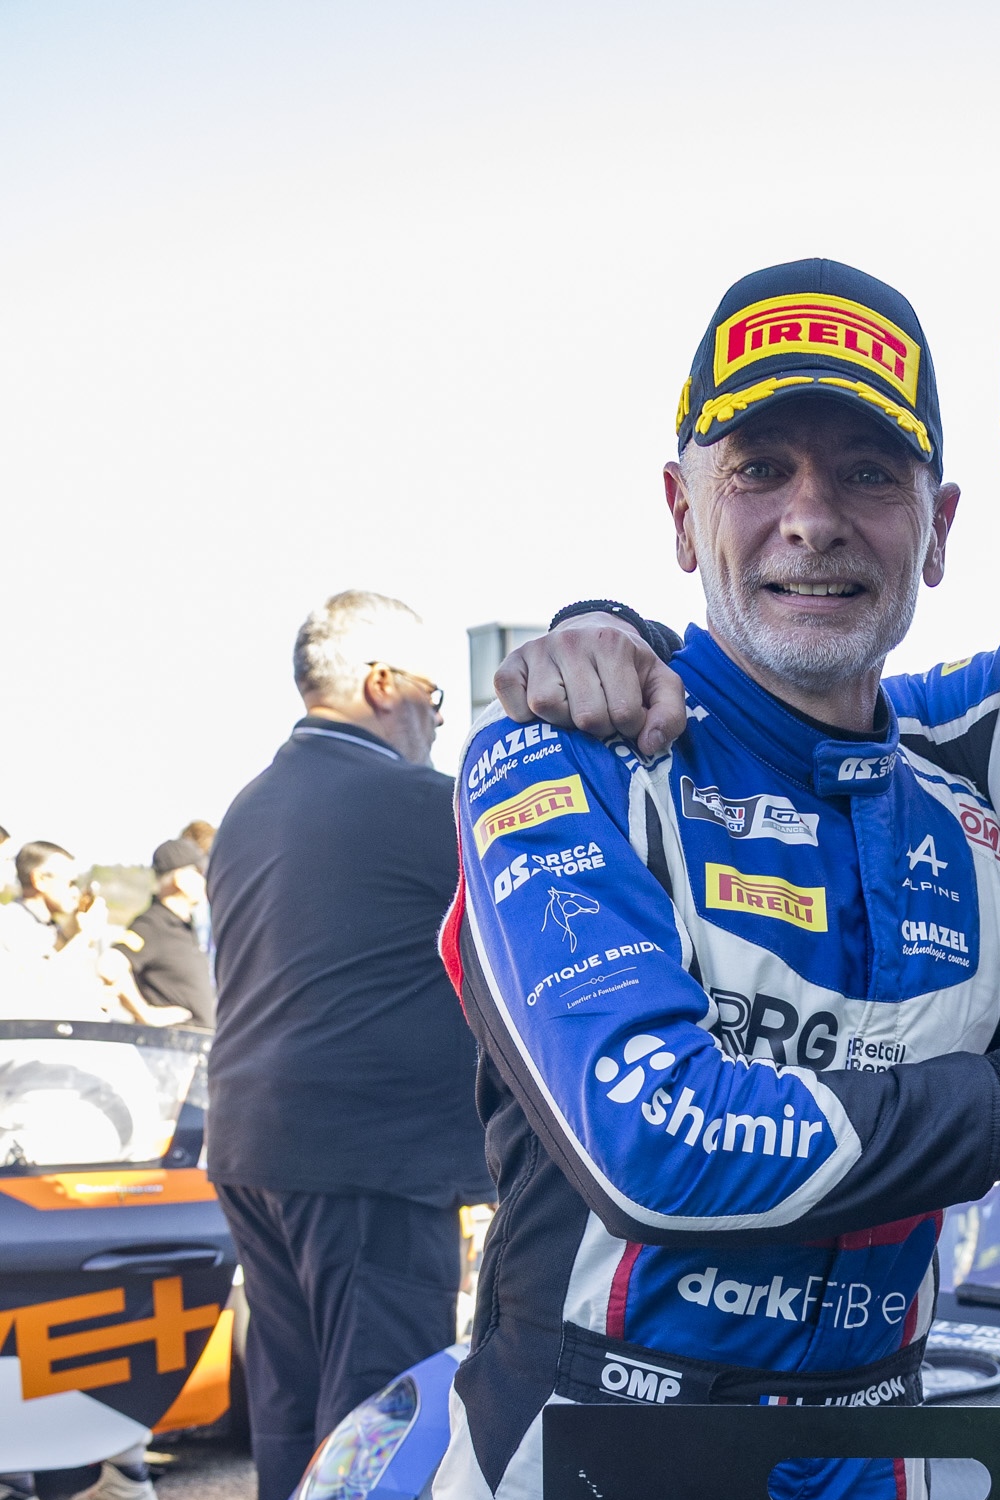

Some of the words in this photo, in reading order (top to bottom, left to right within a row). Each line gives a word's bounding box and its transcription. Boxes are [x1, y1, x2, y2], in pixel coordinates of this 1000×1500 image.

[727, 304, 906, 382] PIRELLI
[468, 723, 558, 789] CHAZEL
[469, 758, 519, 804] technologie
[522, 744, 562, 765] course
[480, 786, 574, 847] PIRELLI
[719, 873, 814, 923] PIRELLI
[902, 877, 960, 903] ALPINE
[902, 919, 969, 953] CHAZEL
[902, 942, 946, 962] technologie
[948, 952, 970, 968] course
[527, 954, 602, 1007] OPTIQUE
[567, 994, 592, 1009] Lunetier
[598, 977, 640, 997] Fontainebleau
[851, 1037, 906, 1063] Retail
[642, 1087, 823, 1158] shamir
[601, 1362, 681, 1404] OMP
